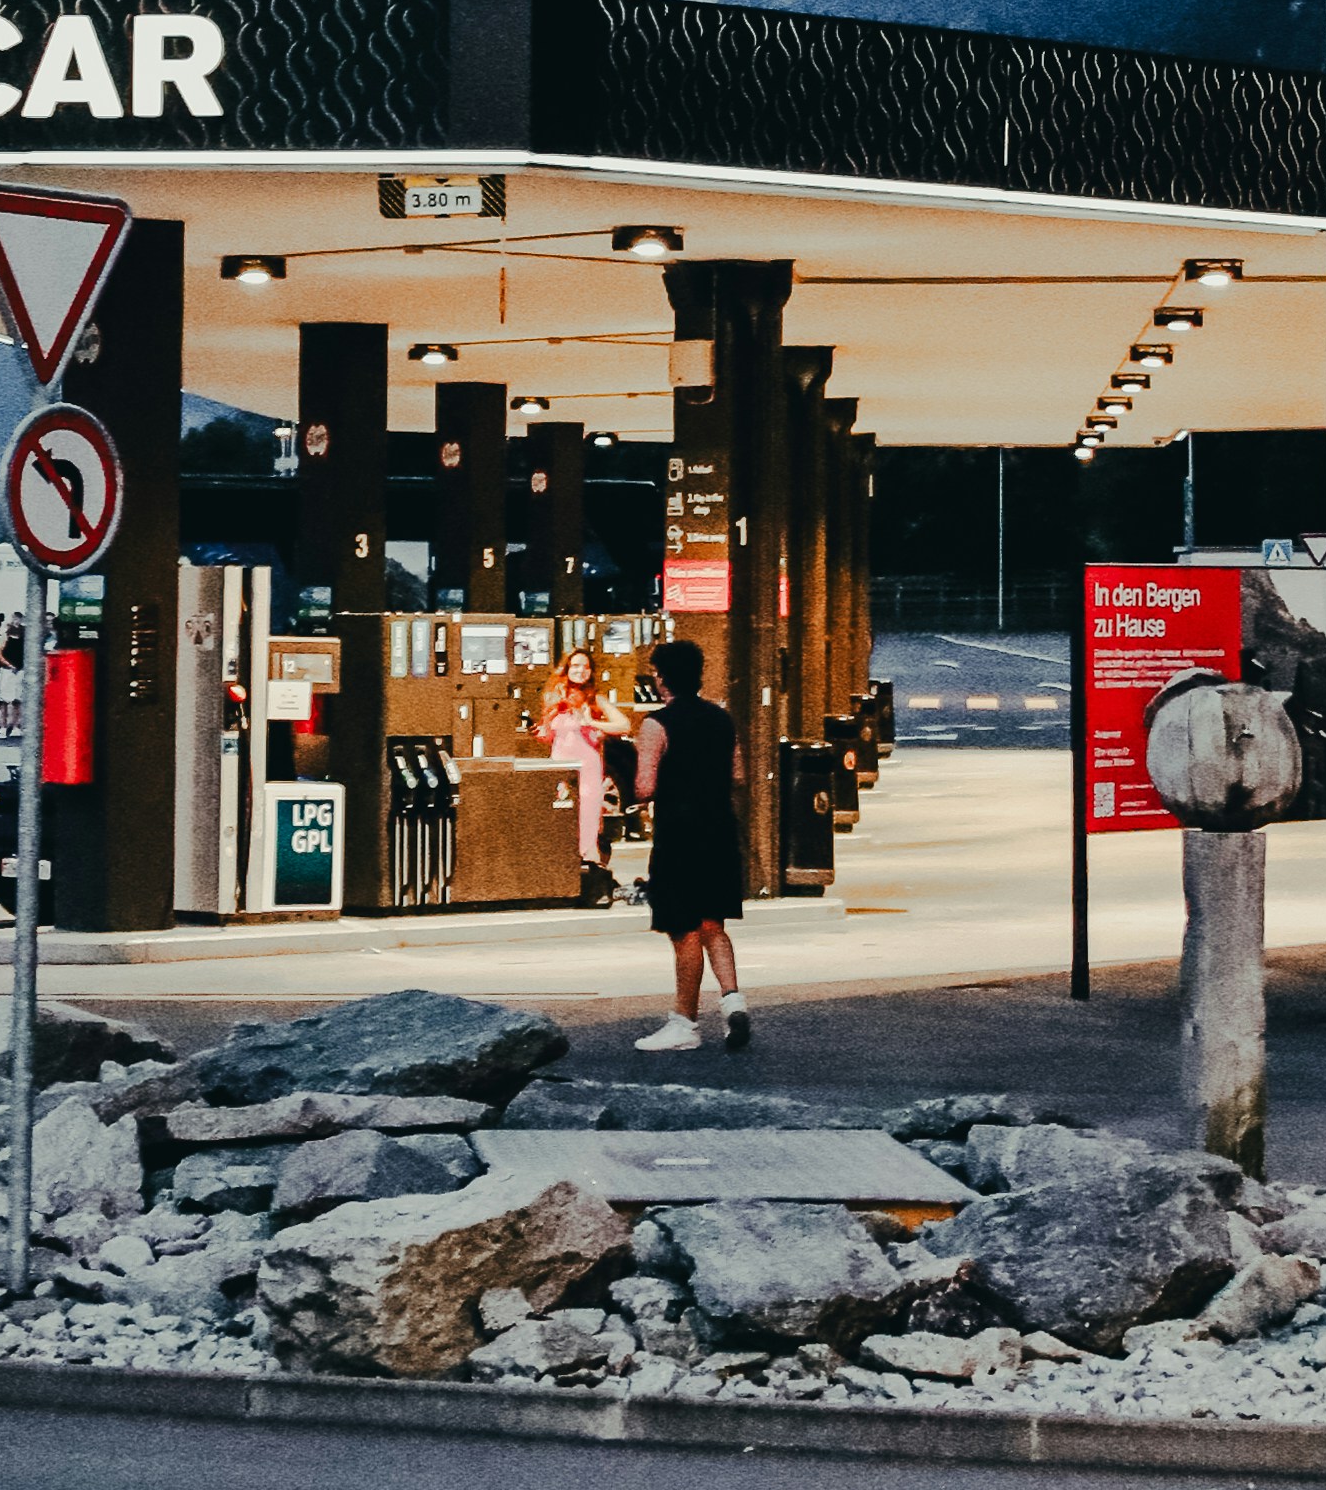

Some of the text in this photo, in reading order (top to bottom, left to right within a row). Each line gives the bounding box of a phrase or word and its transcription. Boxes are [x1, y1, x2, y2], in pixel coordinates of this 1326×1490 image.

[411, 192, 471, 208] 3.80 m
[735, 516, 748, 547] 1
[354, 533, 369, 559] 3
[483, 547, 495, 569] 5
[564, 556, 575, 574] 7
[1094, 582, 1201, 613] In den Bergen
[1094, 613, 1166, 638] zu Hause
[291, 803, 333, 827] LPG
[291, 829, 332, 853] GPL
